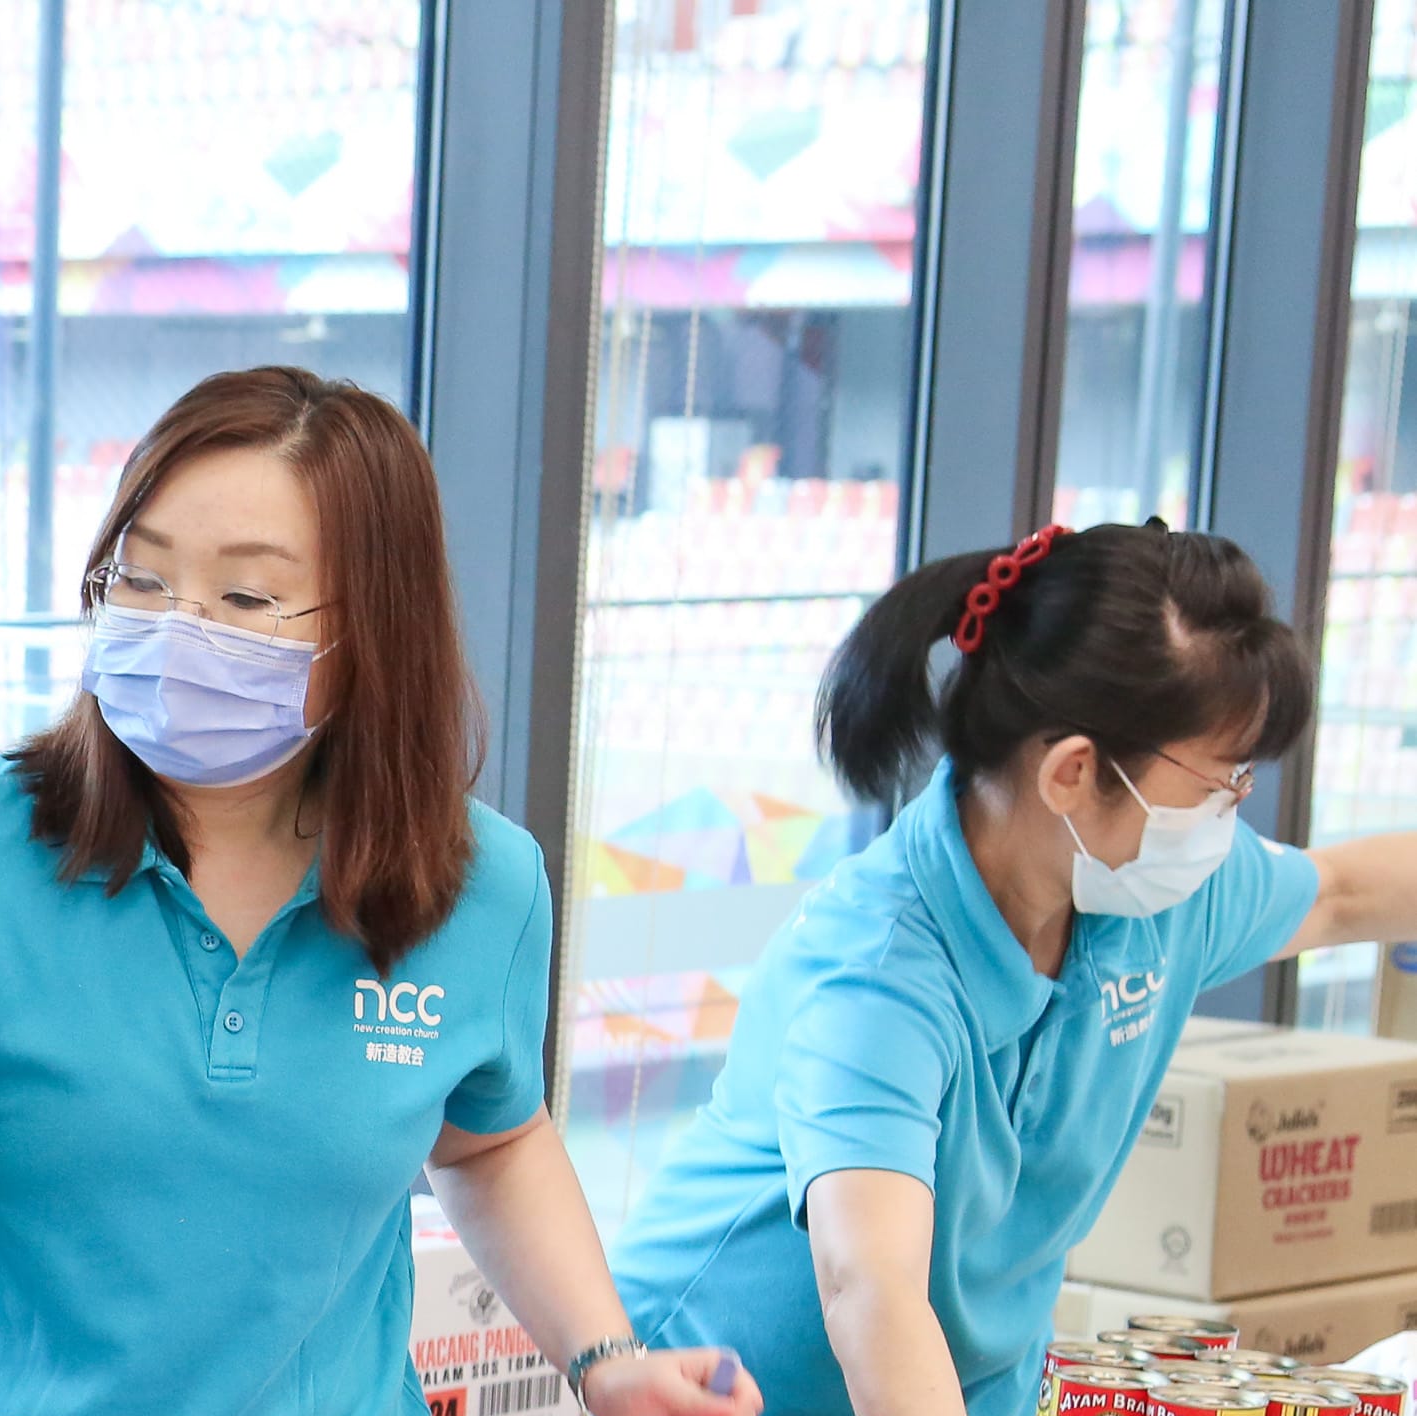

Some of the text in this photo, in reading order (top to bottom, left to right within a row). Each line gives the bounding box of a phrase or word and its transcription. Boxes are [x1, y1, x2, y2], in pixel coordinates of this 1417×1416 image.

[354, 1023, 439, 1039] new creation church
[366, 1042, 425, 1066] 新造教会
[1258, 1131, 1362, 1182] WHEAT
[416, 1331, 479, 1370] KACANG
[1060, 1392, 1146, 1413] AYAM BRA
